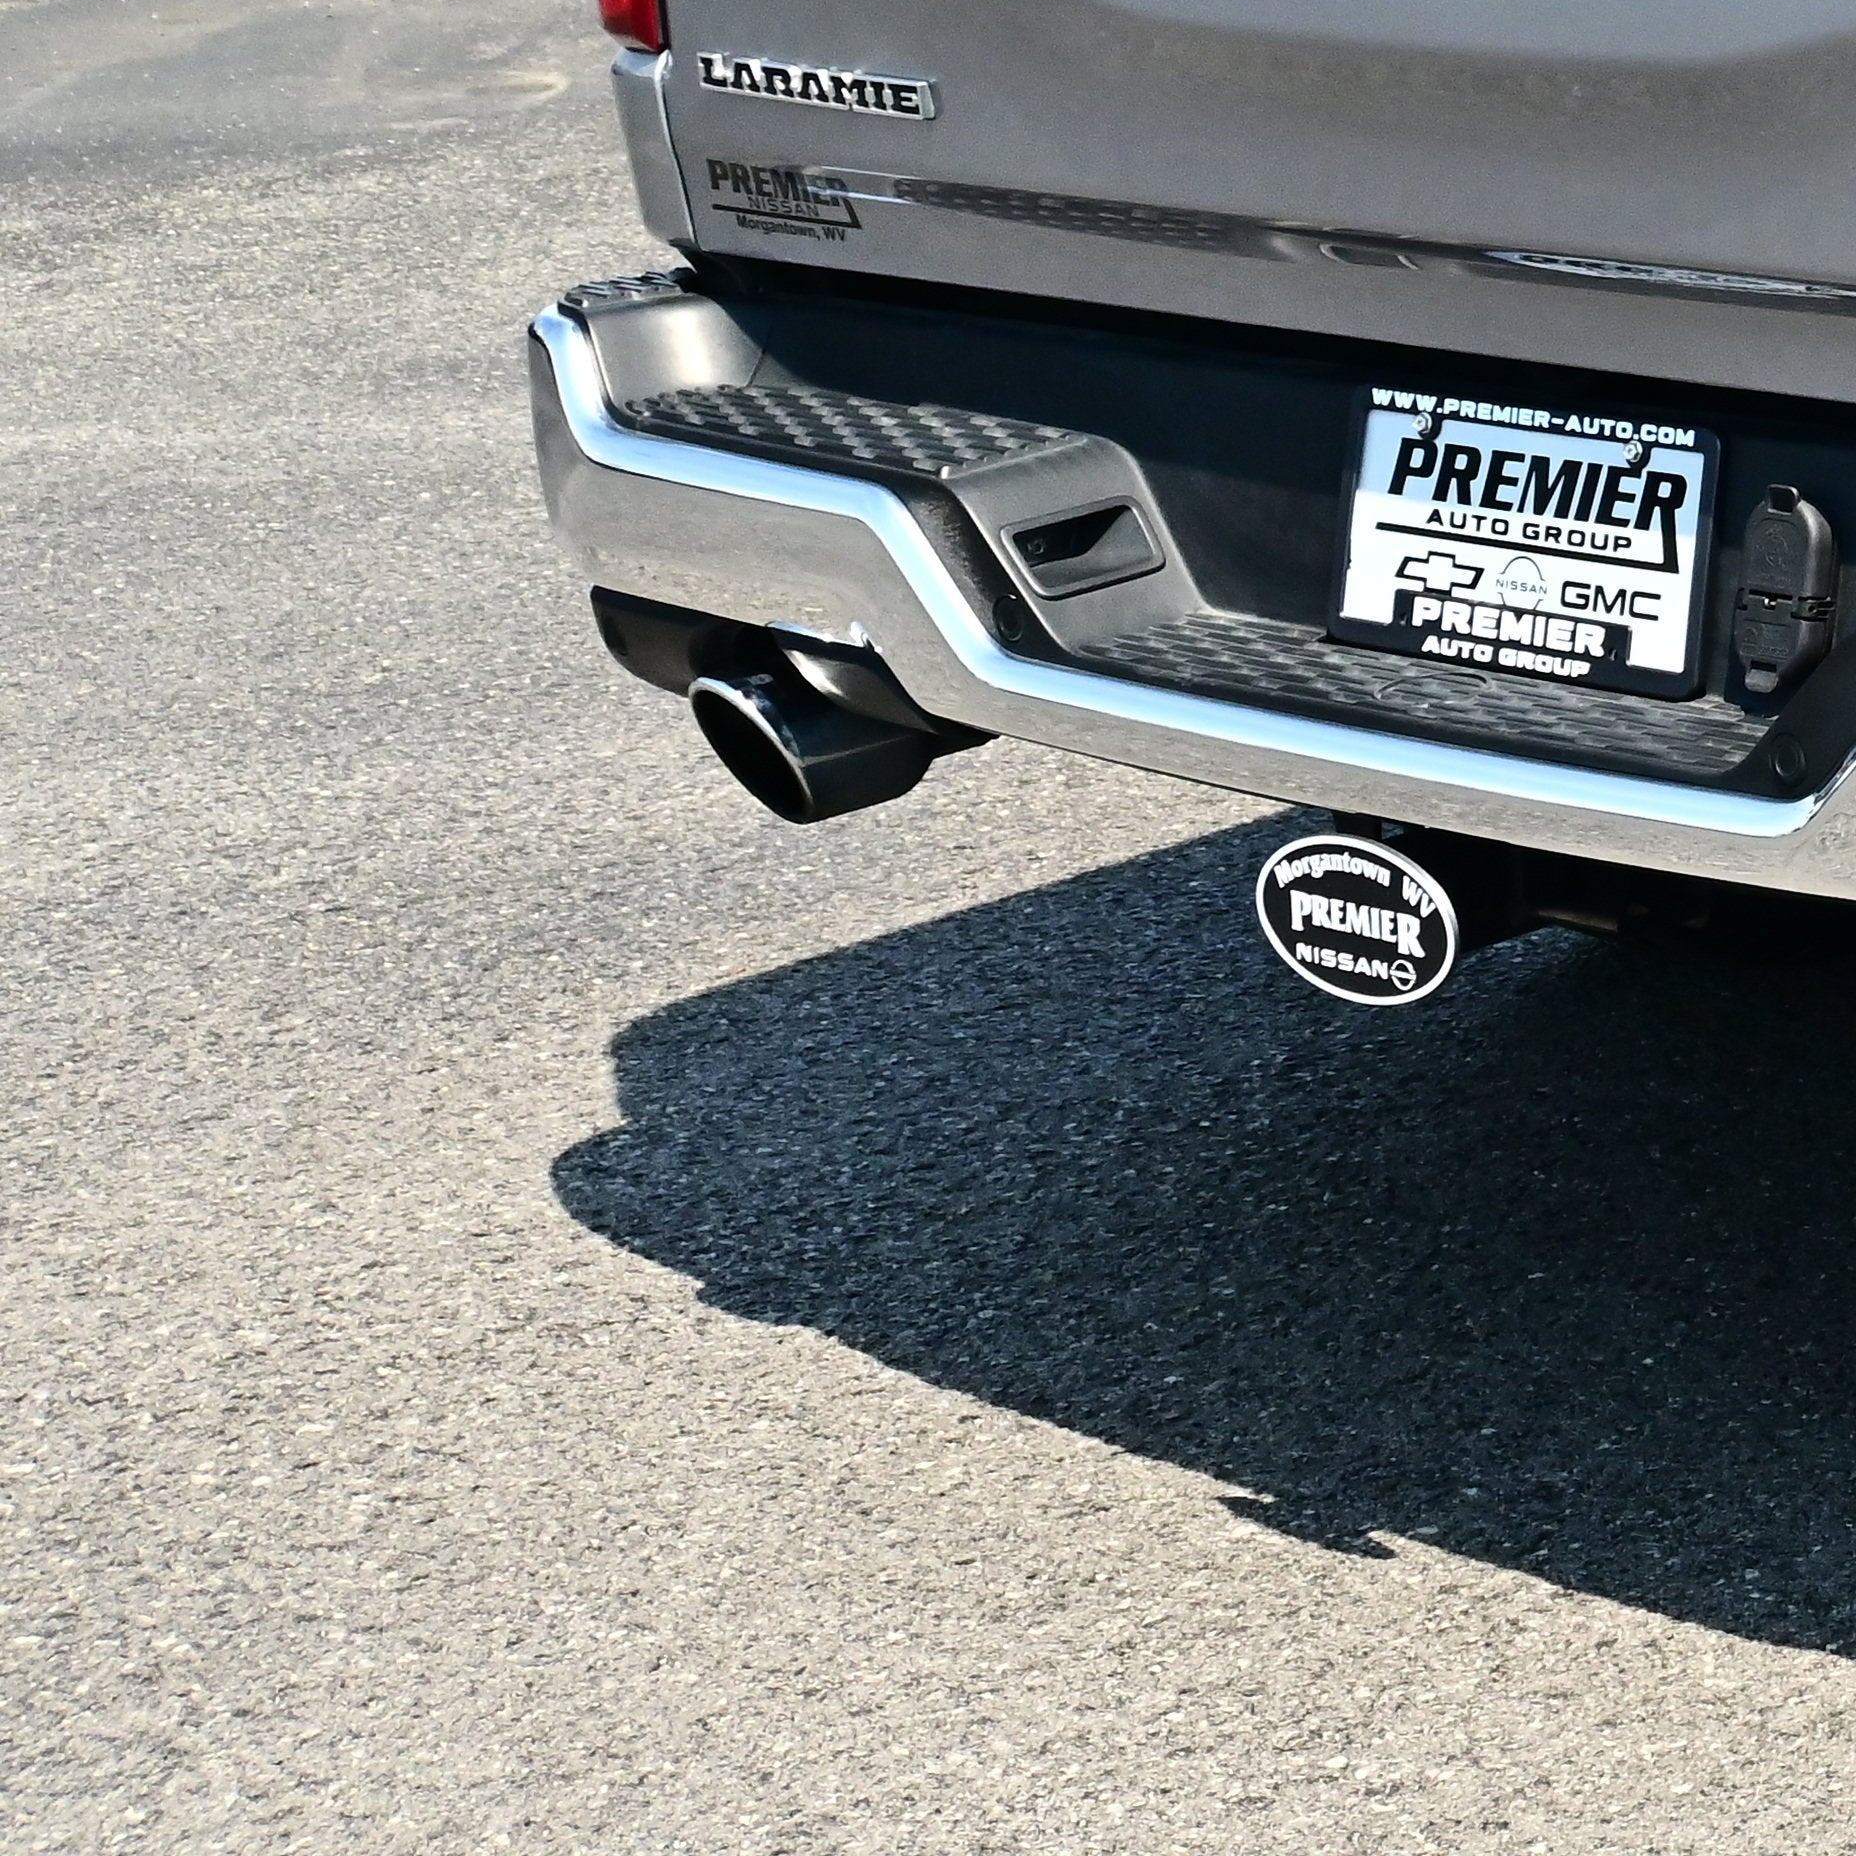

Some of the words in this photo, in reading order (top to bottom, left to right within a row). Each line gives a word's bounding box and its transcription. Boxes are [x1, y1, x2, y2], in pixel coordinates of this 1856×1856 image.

[697, 51, 936, 120] LARAMIE
[706, 158, 849, 208] PREMIER
[748, 196, 820, 217] NISSAN
[736, 214, 820, 241] Morgantown,
[822, 225, 846, 242] WV
[1371, 387, 1695, 447] WWW.PREMIER-AUTO.COM
[1387, 436, 1688, 534] PREMIER
[1426, 508, 1509, 537] AUTO
[1522, 523, 1633, 553] GROUP
[1495, 578, 1548, 596] NISSAN
[1560, 581, 1662, 622] GMC
[1411, 596, 1606, 657] PREMIER
[1421, 635, 1495, 663] AUTO
[1497, 650, 1592, 678] GROUP
[1273, 851, 1391, 888] Morgantown
[1402, 875, 1437, 918] WV
[1289, 889, 1426, 958] PREMIER
[1295, 942, 1389, 980] NISSAN
